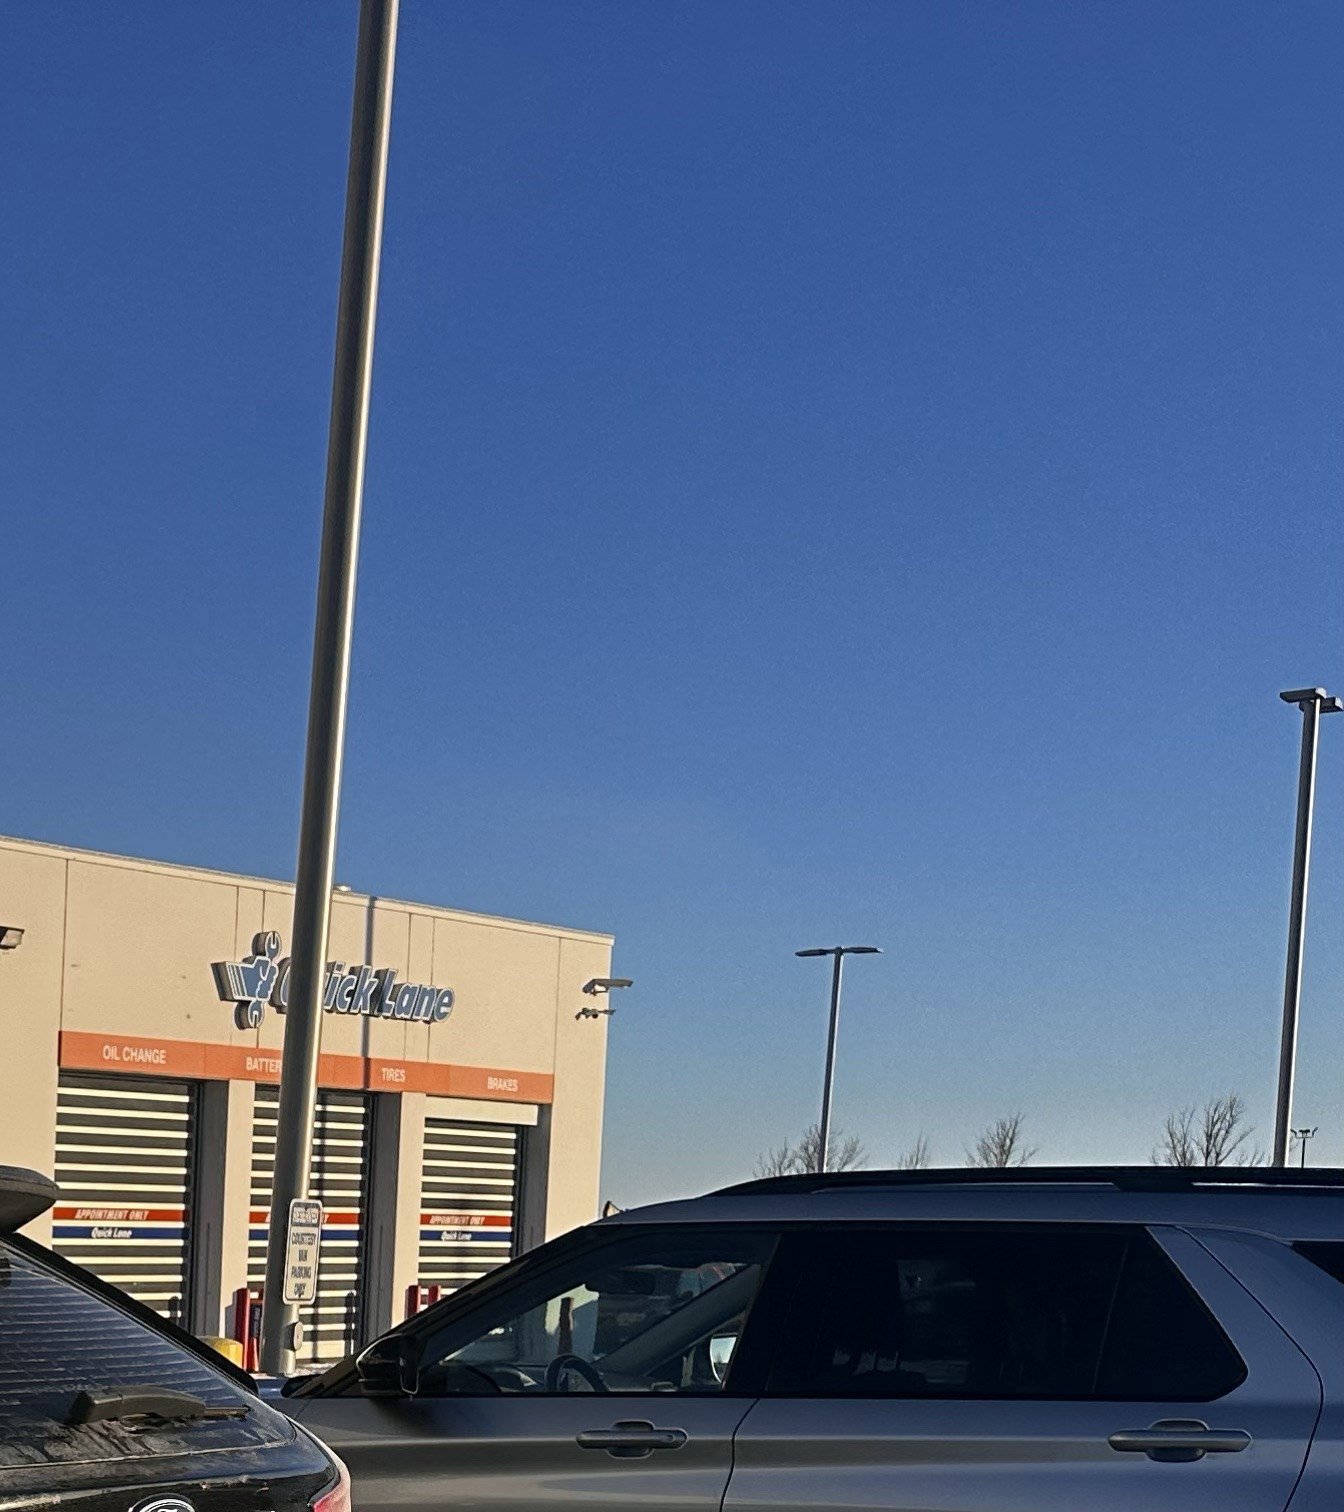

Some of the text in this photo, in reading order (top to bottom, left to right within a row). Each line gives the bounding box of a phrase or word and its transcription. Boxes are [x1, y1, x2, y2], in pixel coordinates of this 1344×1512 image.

[279, 961, 456, 1023] ick Lane
[102, 1045, 167, 1065] OIL CHANGE
[245, 1056, 283, 1072] BATTER
[381, 1067, 406, 1083] TIRES
[487, 1076, 519, 1092] BRAKES
[74, 1208, 151, 1221] APPOINTMENT ONLY
[91, 1227, 132, 1239] Quick Lane
